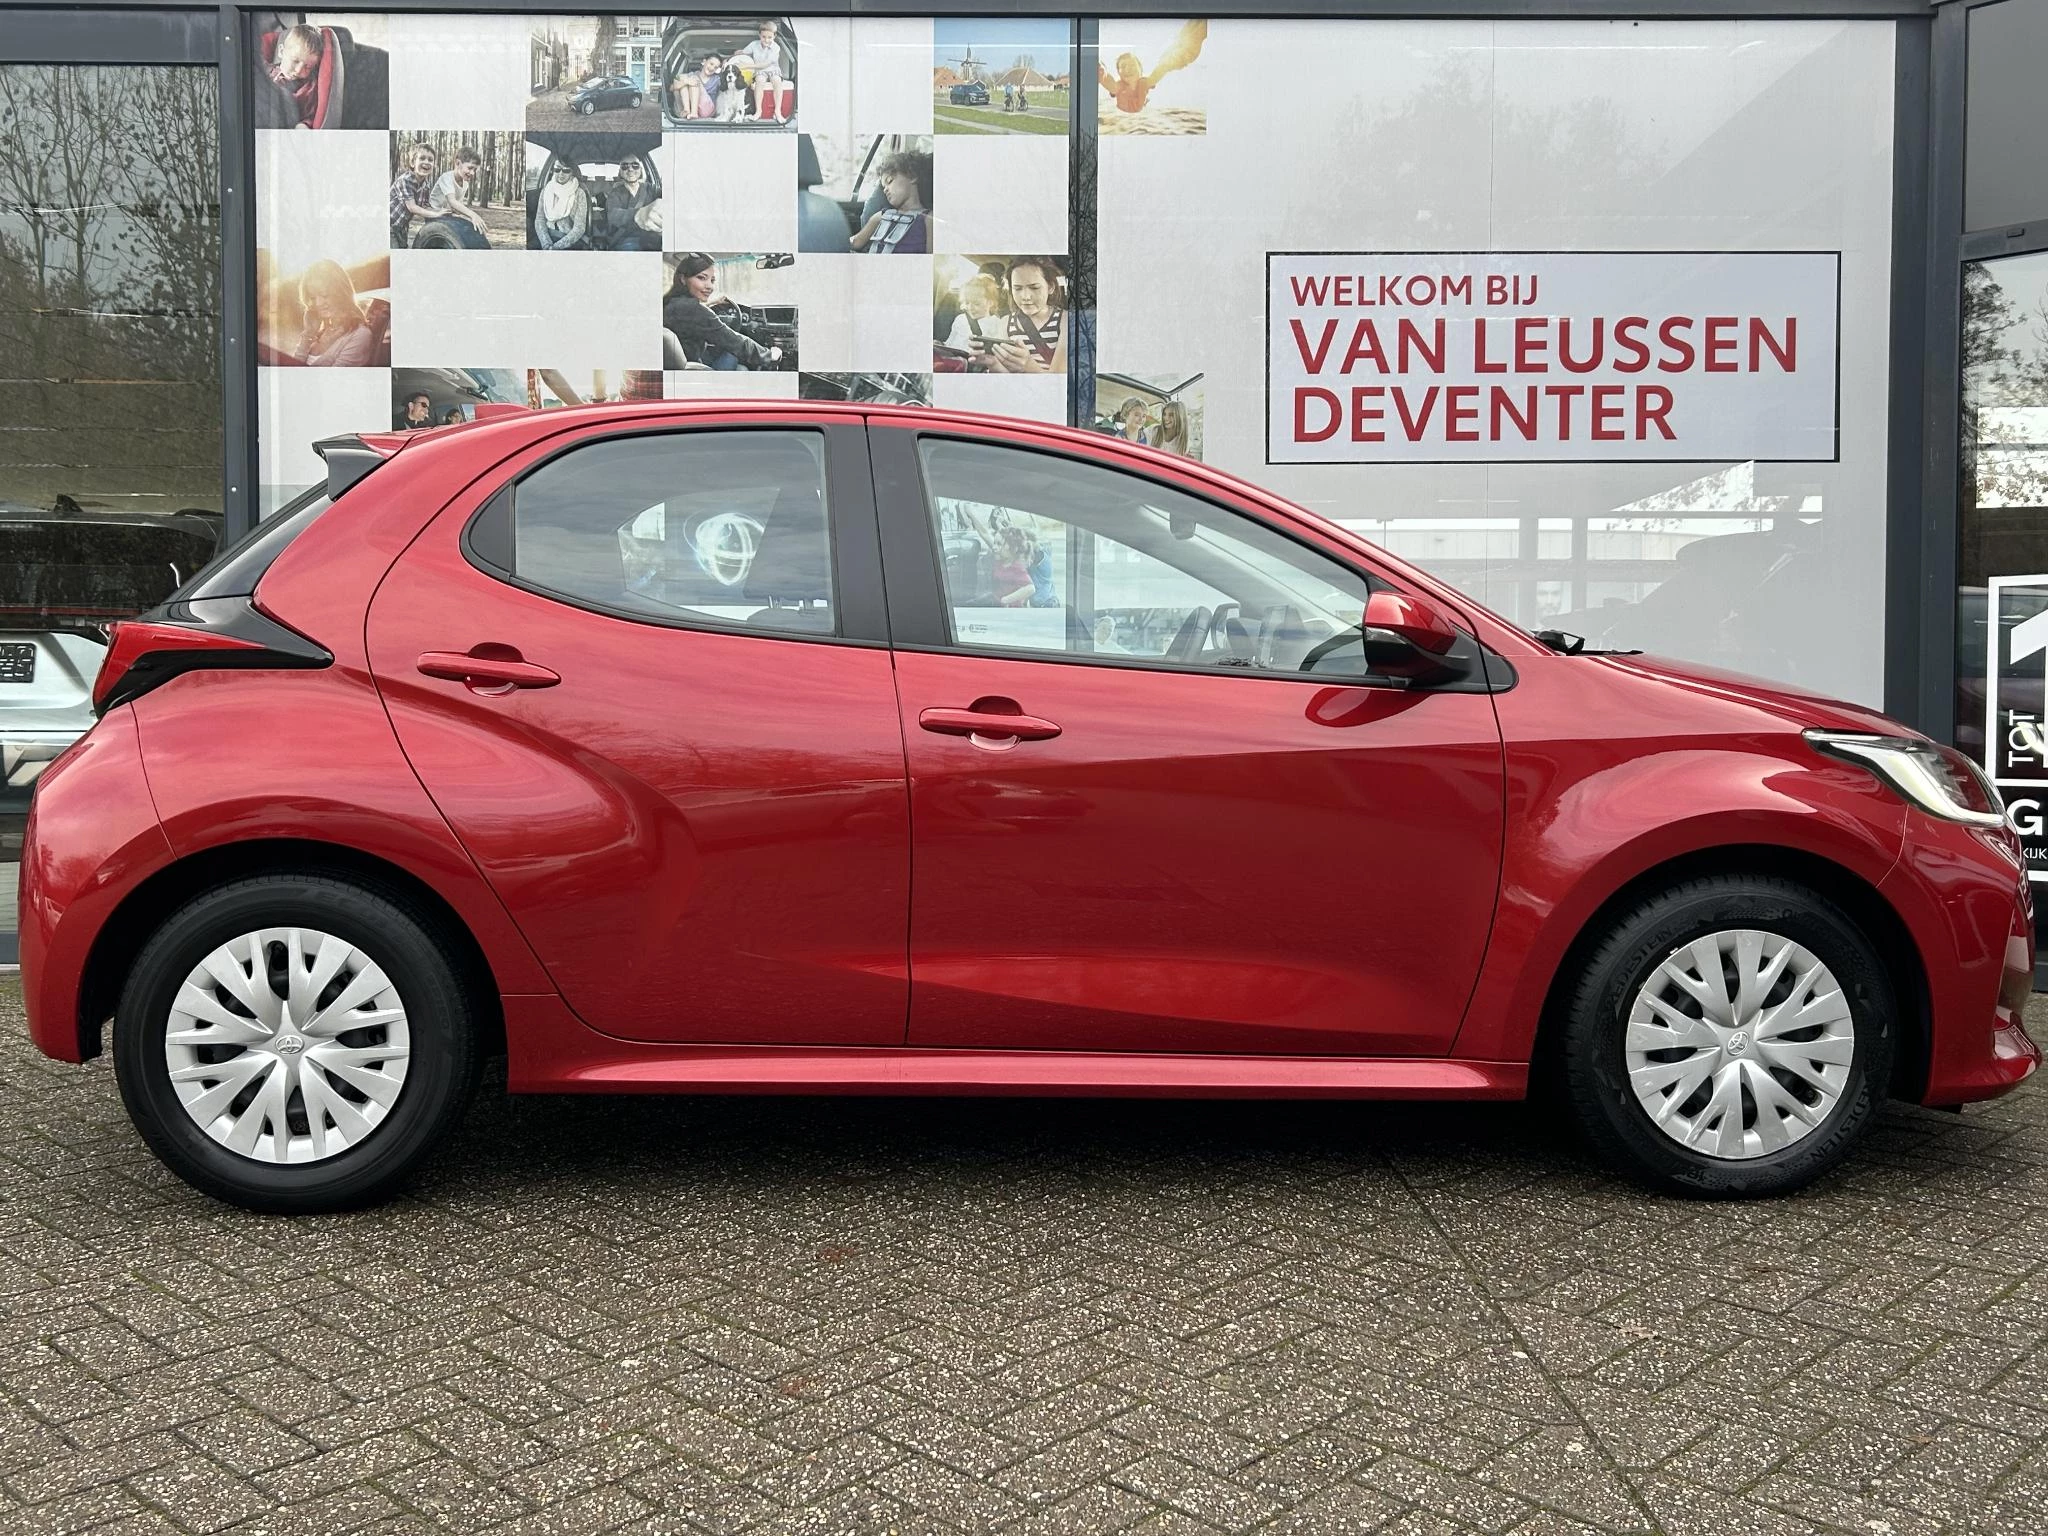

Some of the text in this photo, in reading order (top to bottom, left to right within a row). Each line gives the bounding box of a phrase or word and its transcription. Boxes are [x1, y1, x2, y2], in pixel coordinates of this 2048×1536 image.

[1290, 275, 1538, 306] WELKOM BIJ
[1290, 316, 1797, 375] VAN LEUSSEN
[1292, 385, 1677, 443] DEVENTER
[2007, 709, 2036, 768] TOT
